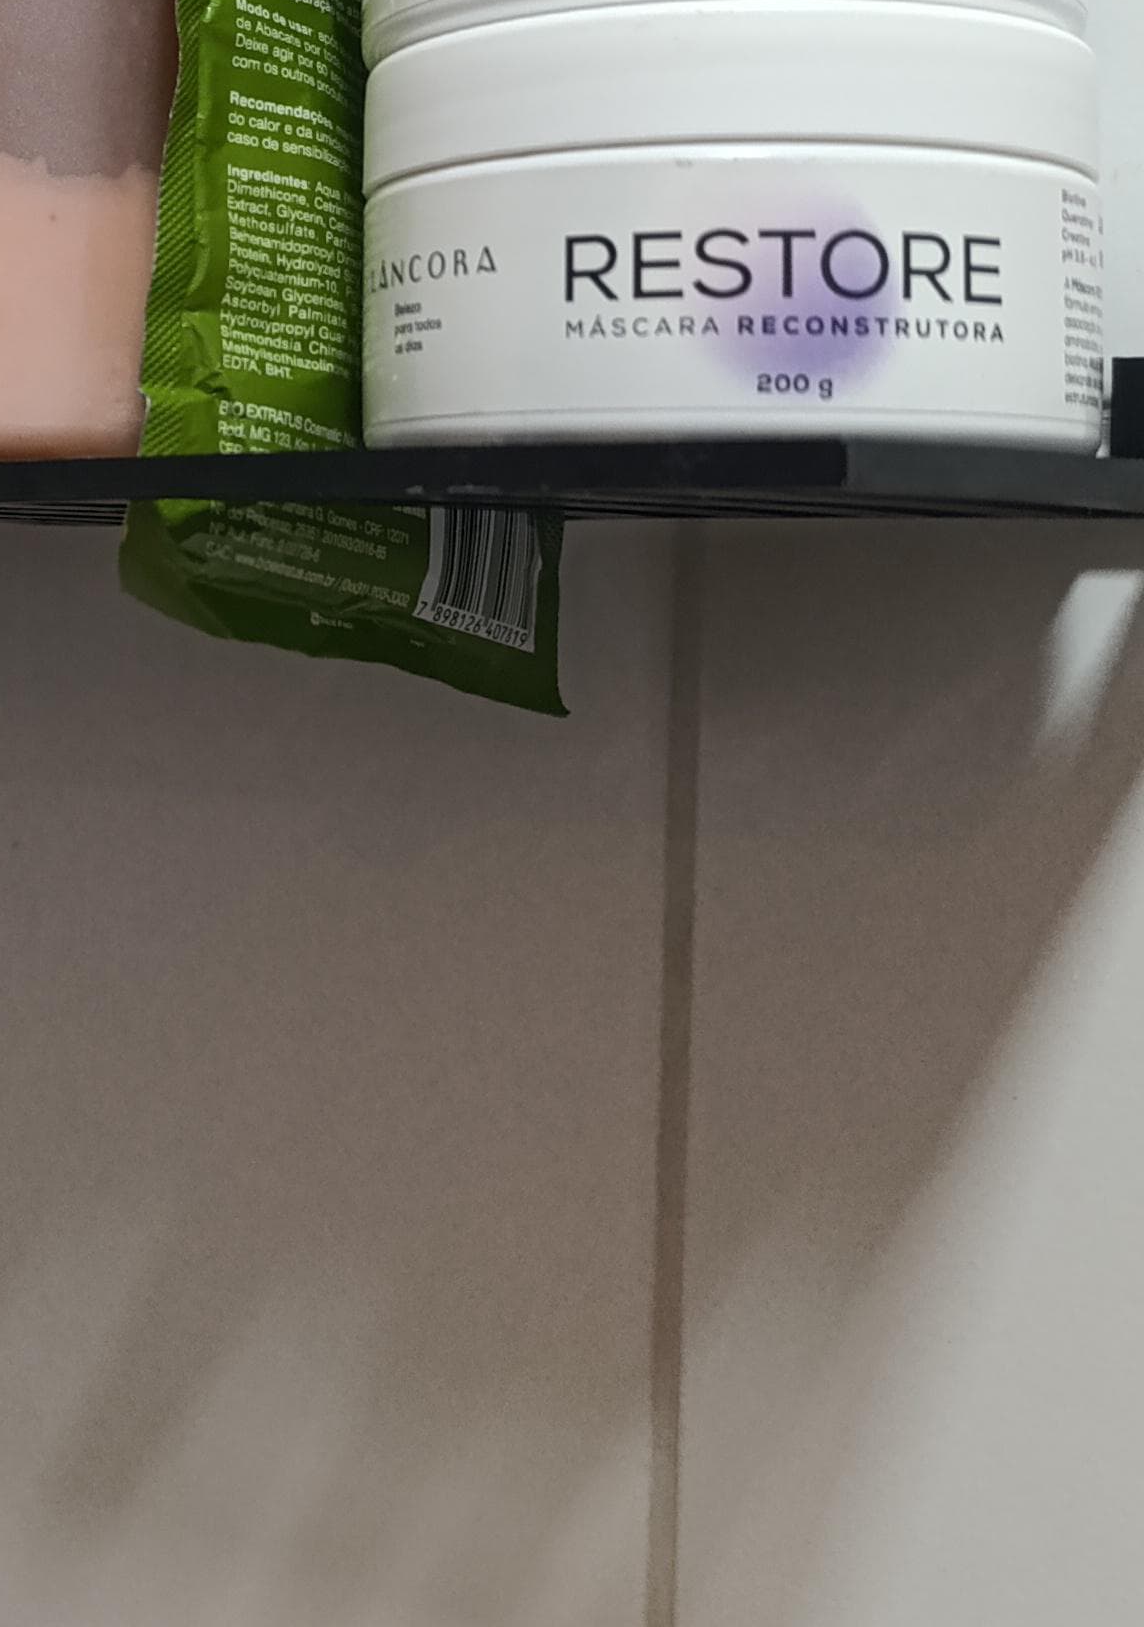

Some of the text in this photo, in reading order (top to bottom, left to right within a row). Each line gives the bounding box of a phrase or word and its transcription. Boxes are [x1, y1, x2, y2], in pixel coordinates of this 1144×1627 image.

[235, 33, 269, 53] Deixe
[255, 21, 301, 48] Abacate
[232, 55, 315, 87] com outros
[248, 116, 281, 132] calor
[227, 131, 259, 147] caso
[227, 164, 311, 190] Ingredientes:
[564, 228, 1004, 305] RESTORE
[221, 293, 281, 317] Ascorbyl
[220, 309, 314, 338] Hydroxypropyl
[564, 314, 1004, 343] MÁSCARA RECONSTRUTORA
[220, 326, 302, 352] Simmondsia
[222, 355, 261, 375] EDTA,
[756, 374, 834, 400] 200 g
[246, 404, 303, 430] EXTRATUS
[416, 601, 428, 616] 7
[432, 605, 482, 636] 898126
